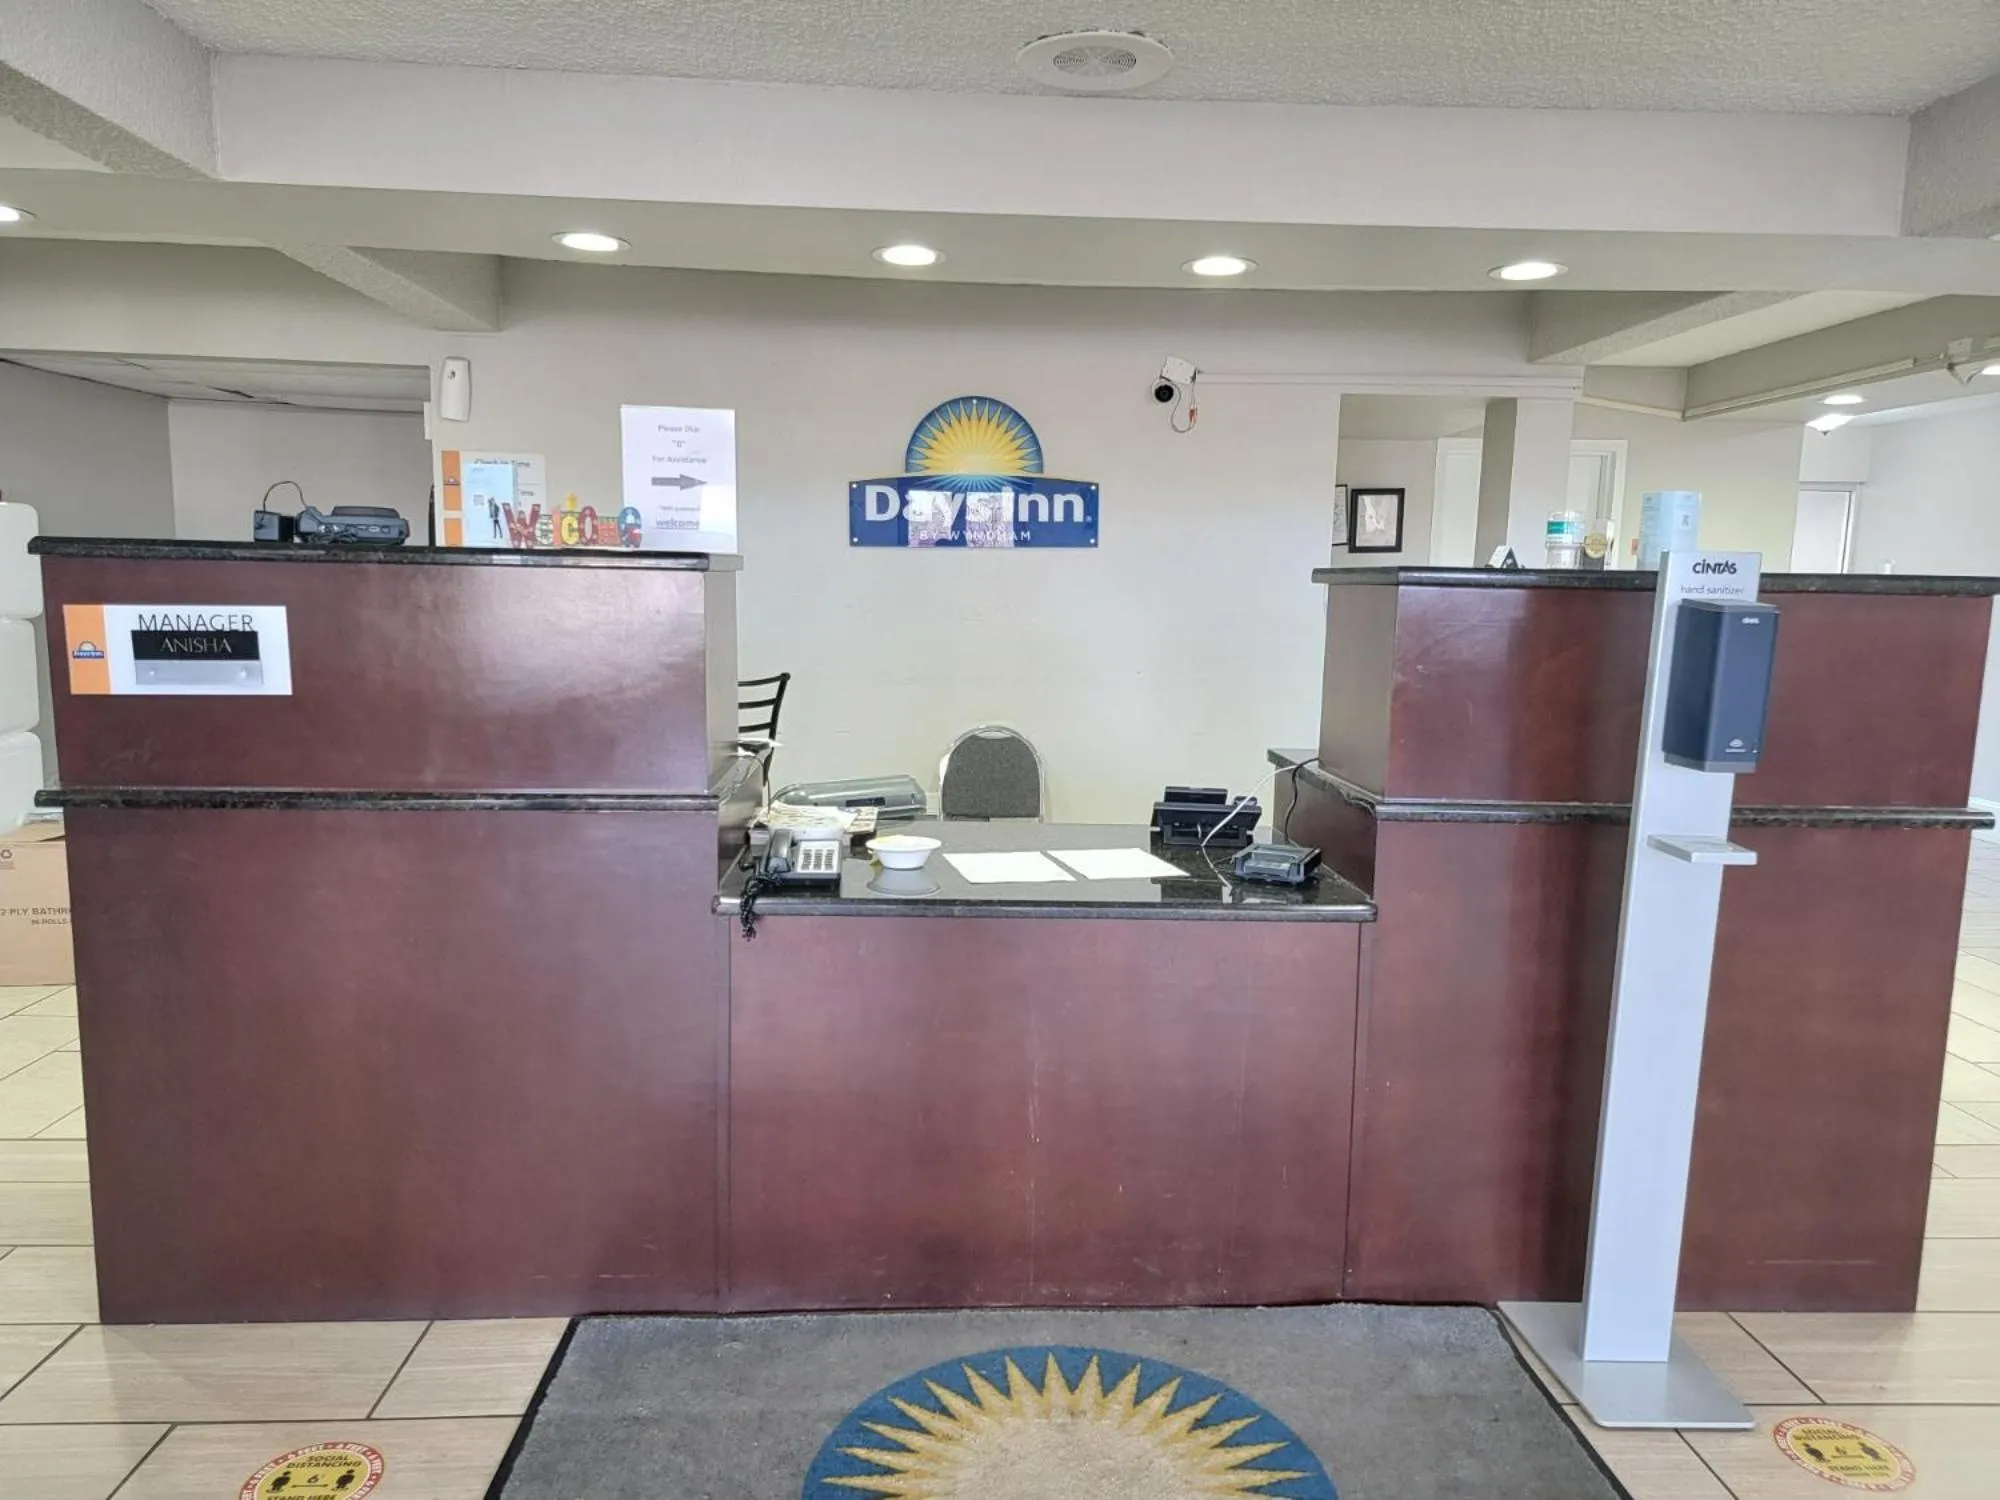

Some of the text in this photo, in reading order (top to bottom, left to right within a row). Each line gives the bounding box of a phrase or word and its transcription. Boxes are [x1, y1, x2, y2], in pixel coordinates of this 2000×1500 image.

[658, 424, 683, 432] Please
[865, 484, 995, 528] Days
[920, 530, 1032, 542] BY WYNDHAM
[1680, 584, 1745, 595] hand sanitizer
[138, 613, 253, 632] MANAGER
[160, 637, 232, 653] ANISHA
[286, 1460, 362, 1469] DISTANCING
